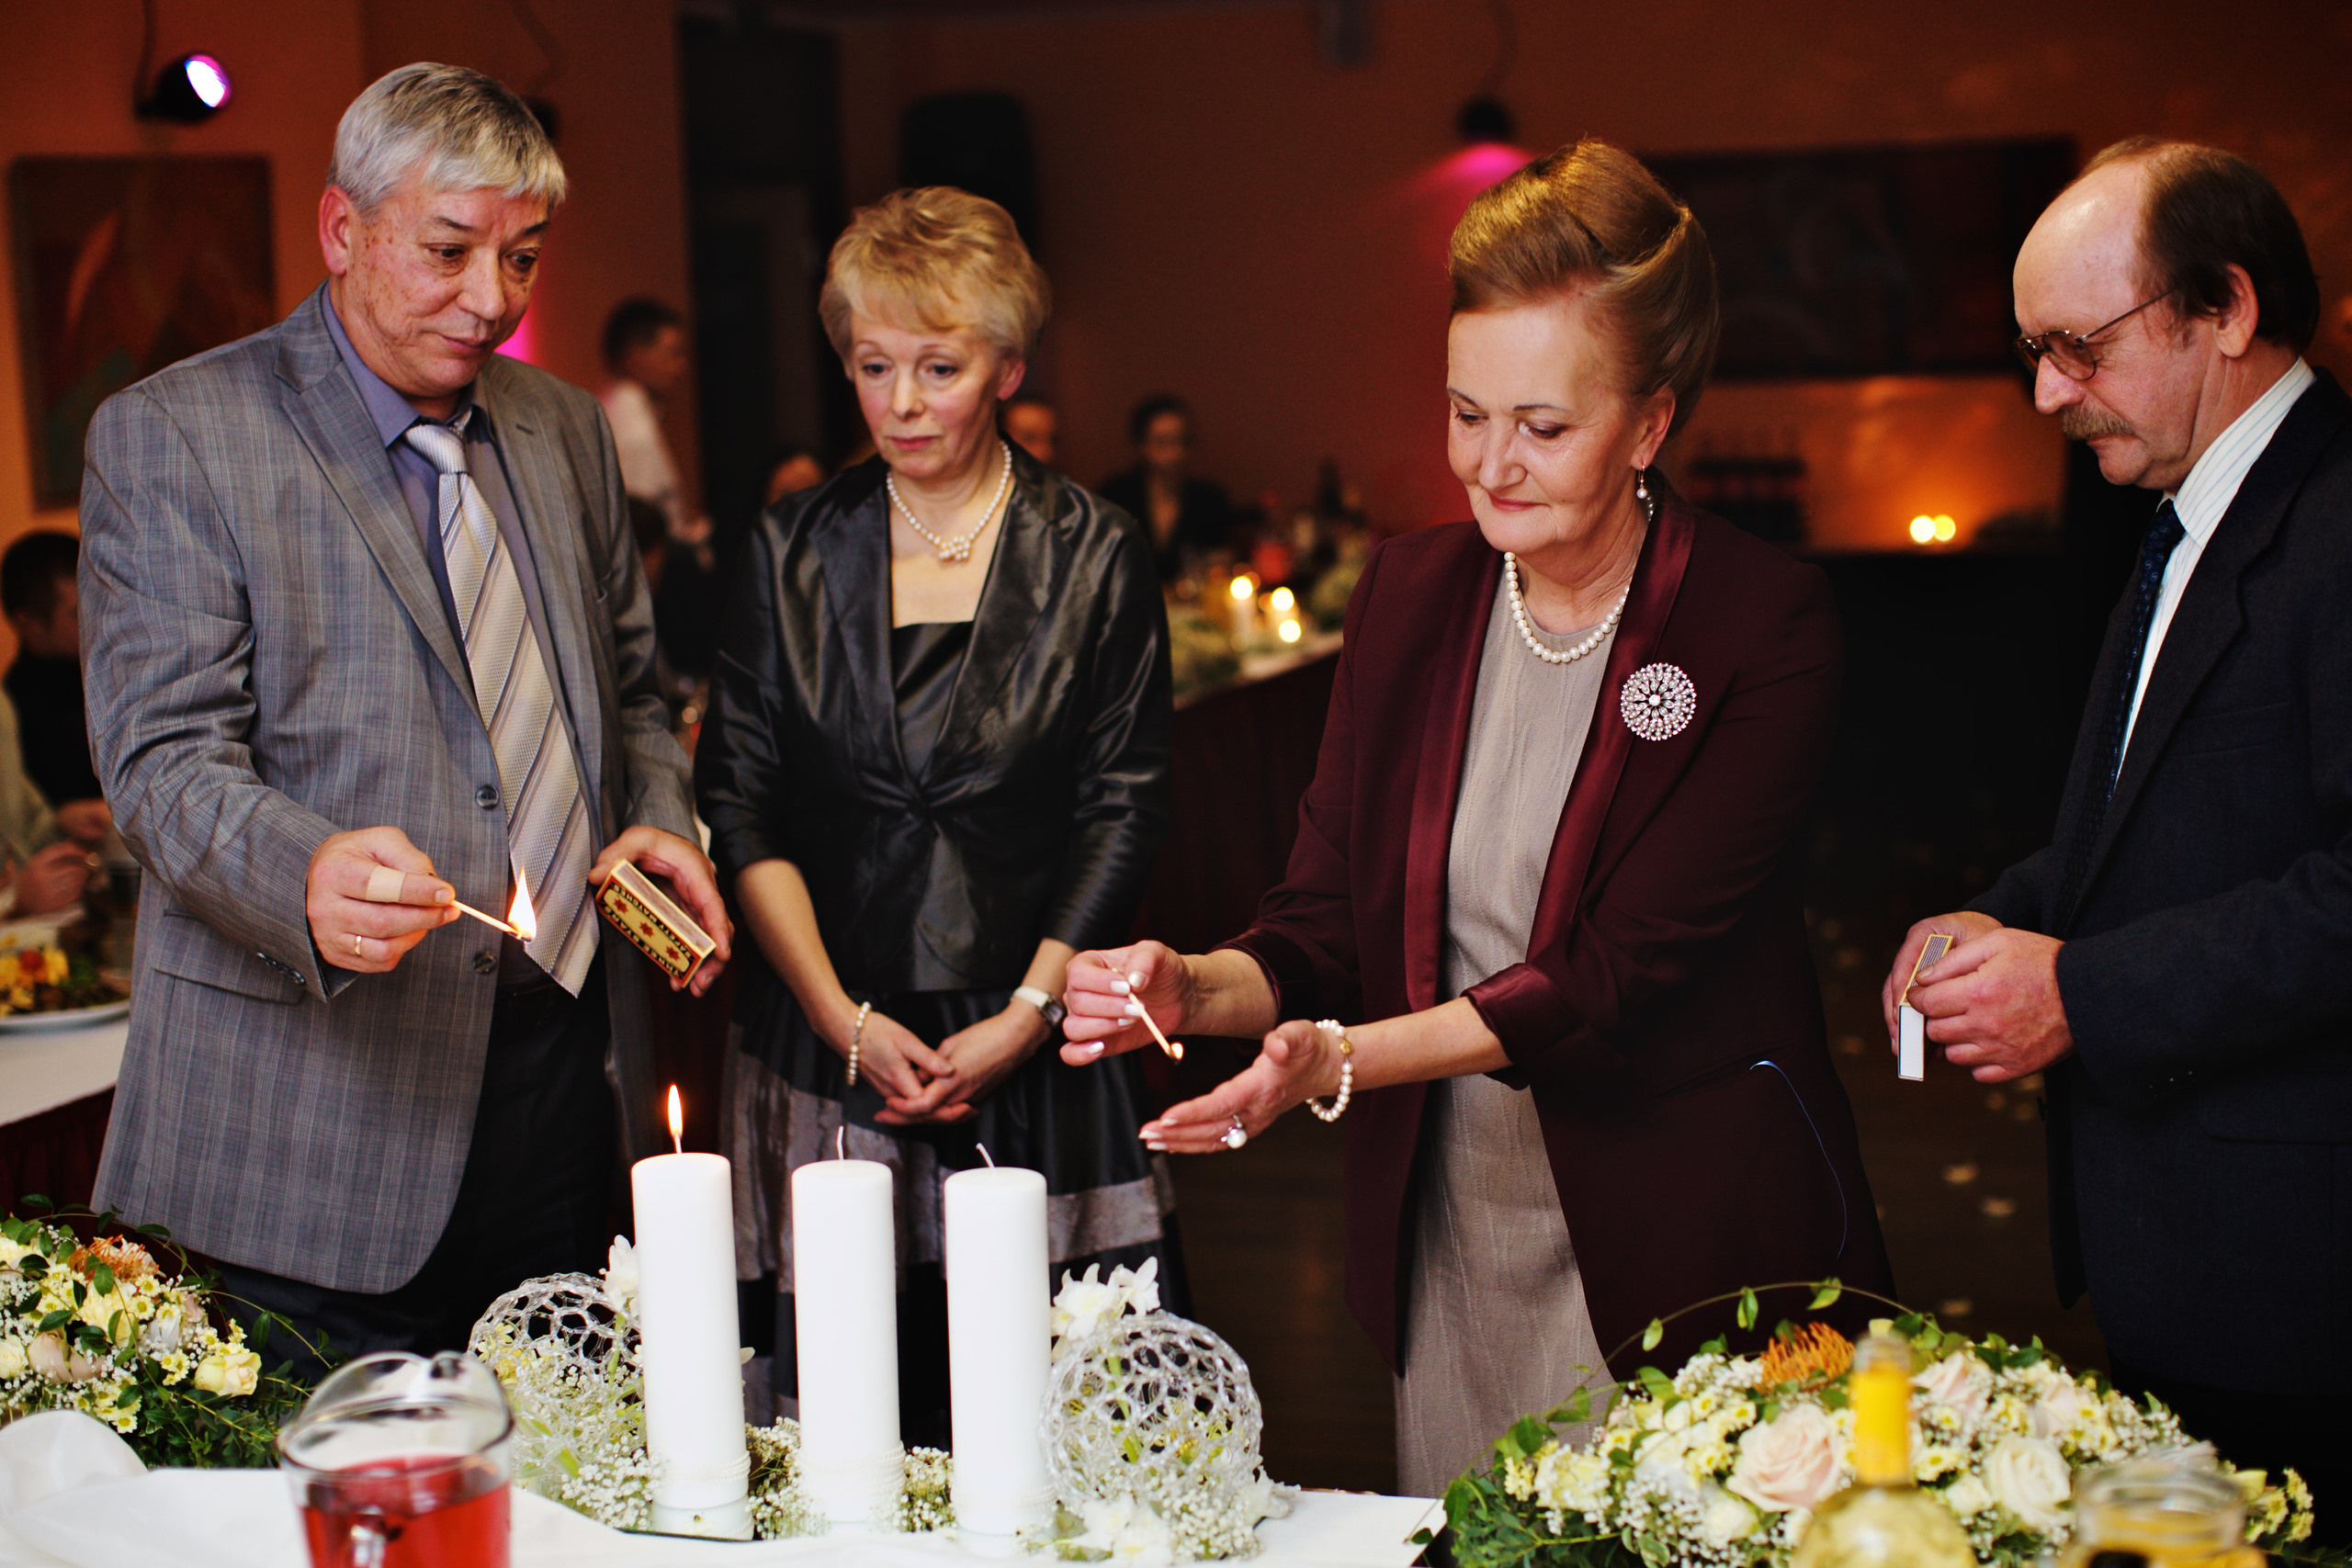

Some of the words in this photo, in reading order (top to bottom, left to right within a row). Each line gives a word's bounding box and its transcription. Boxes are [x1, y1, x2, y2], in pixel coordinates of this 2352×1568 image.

[613, 885, 658, 922] MATCHES
[604, 906, 640, 942] STARS
[659, 924, 691, 957] SAFETY
[642, 944, 679, 976] THREE
